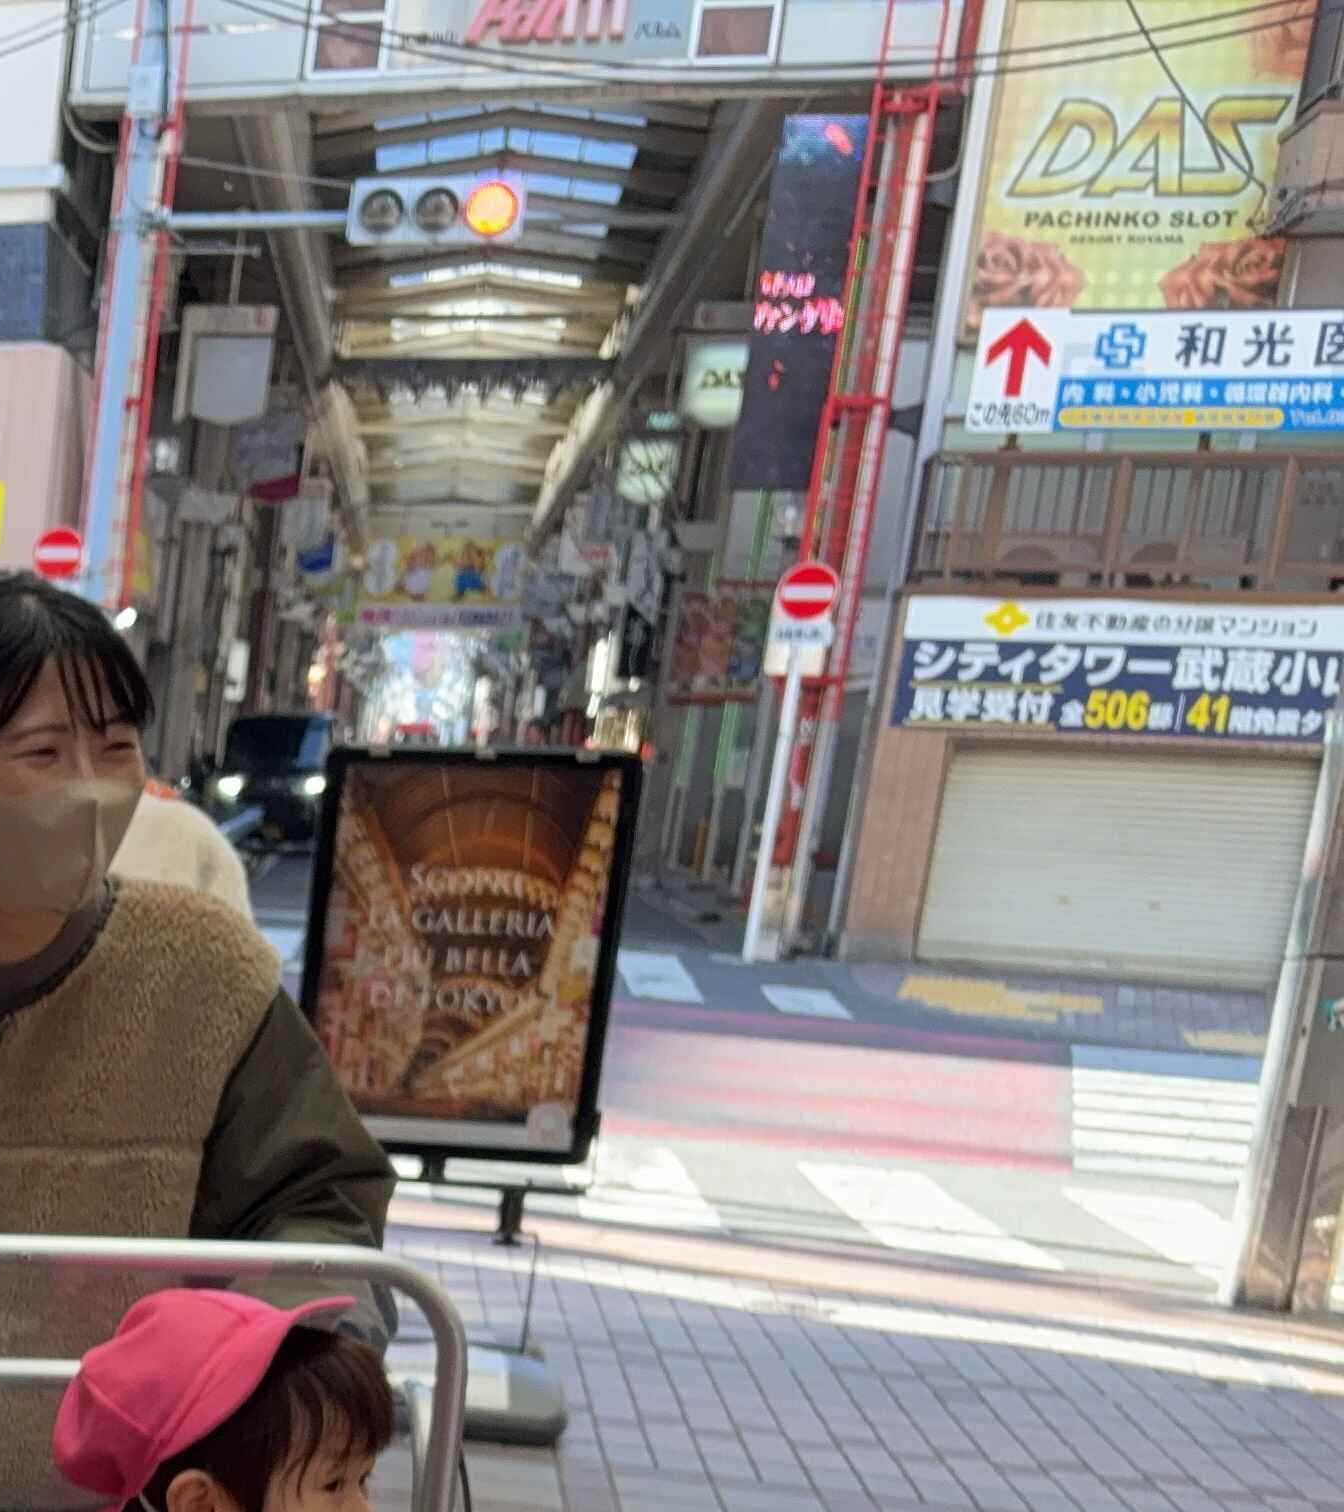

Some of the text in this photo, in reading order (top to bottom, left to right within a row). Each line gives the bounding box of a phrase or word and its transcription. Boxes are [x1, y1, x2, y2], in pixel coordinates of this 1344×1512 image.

[1007, 94, 1293, 198] DAS
[1023, 210, 1239, 229] PACHINKO SLOT
[412, 905, 555, 938] GALLERIA
